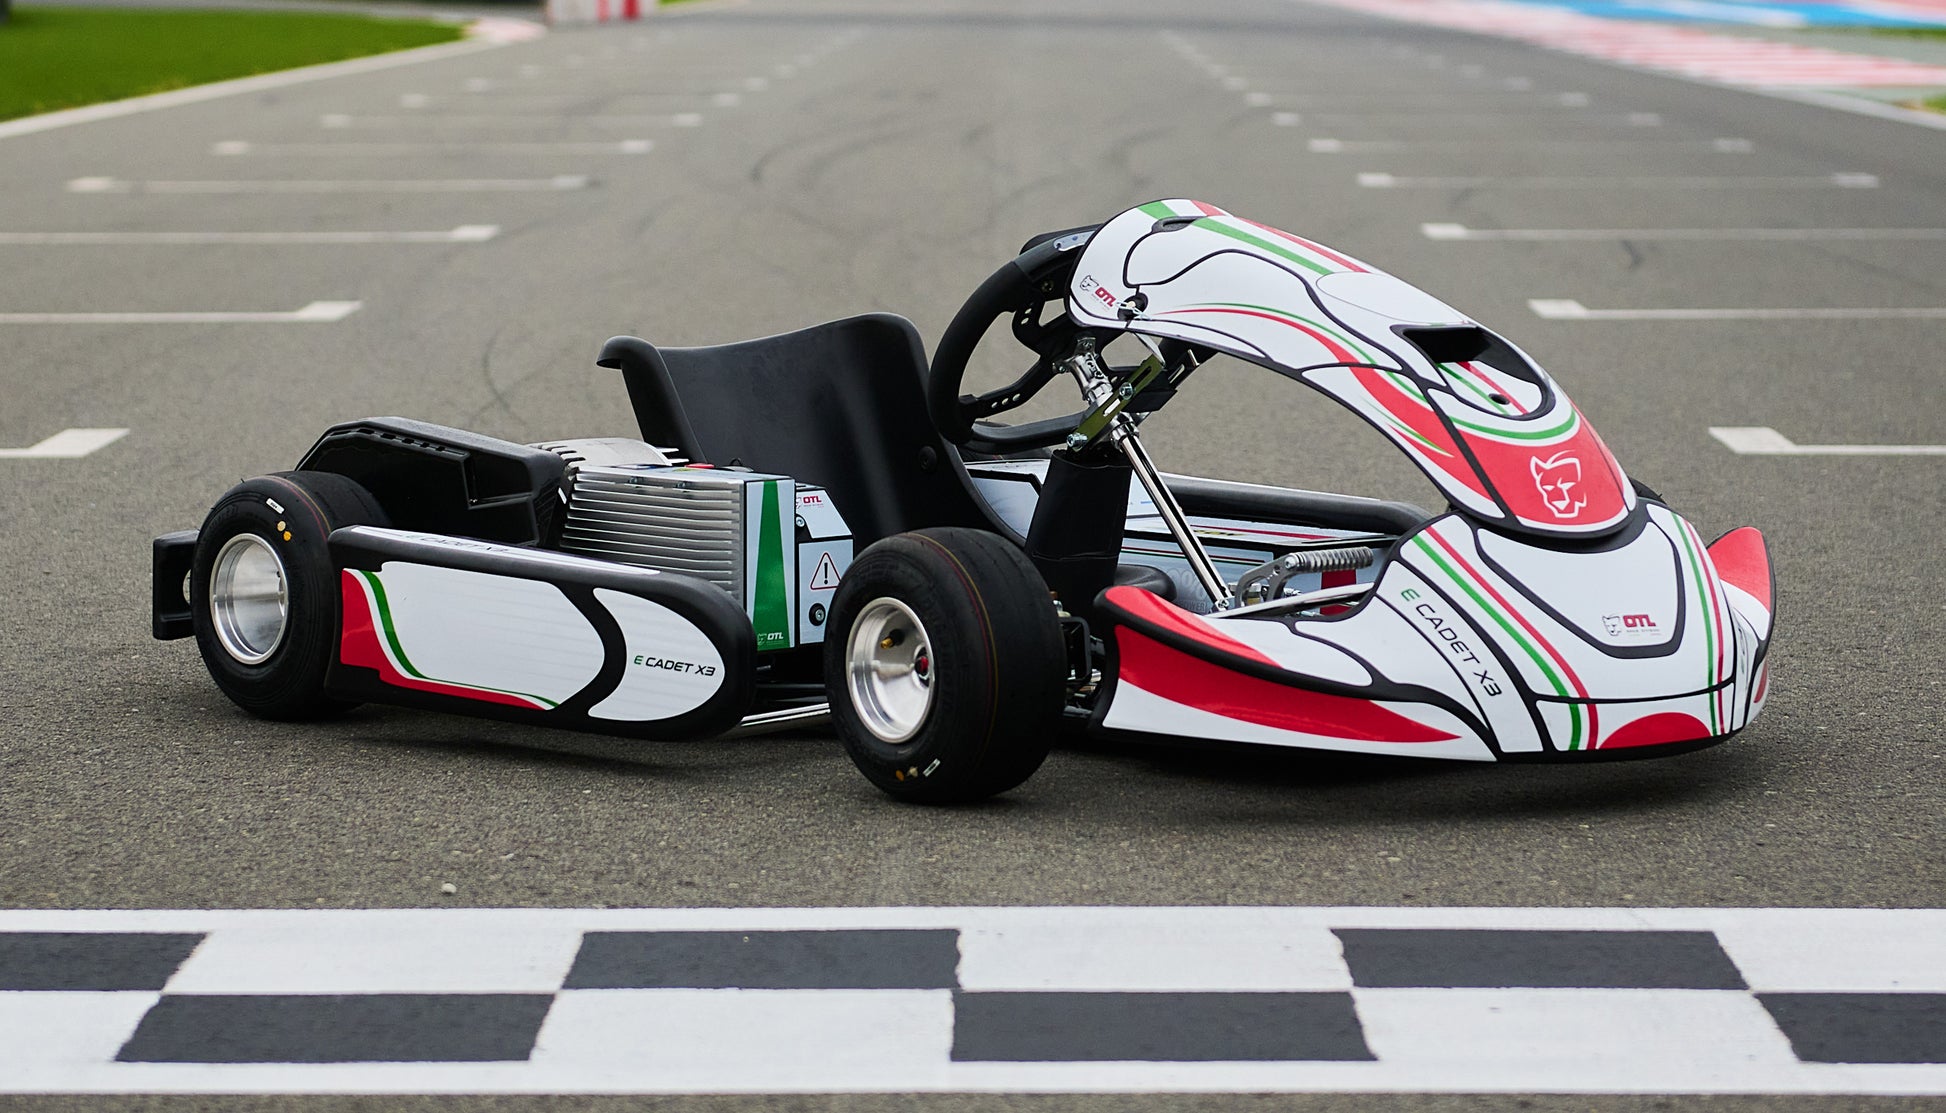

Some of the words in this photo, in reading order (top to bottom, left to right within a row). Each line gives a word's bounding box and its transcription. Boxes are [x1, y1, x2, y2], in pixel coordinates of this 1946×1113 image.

[1095, 287, 1117, 307] OTL
[803, 495, 822, 504] OTL
[1622, 614, 1656, 628] OTL
[767, 632, 784, 641] OTL
[1401, 588, 1421, 602] E
[1416, 603, 1481, 664] CADET
[1473, 670, 1503, 697] X3
[633, 655, 644, 666] E
[645, 657, 695, 673] CADET
[694, 664, 717, 677] X3
